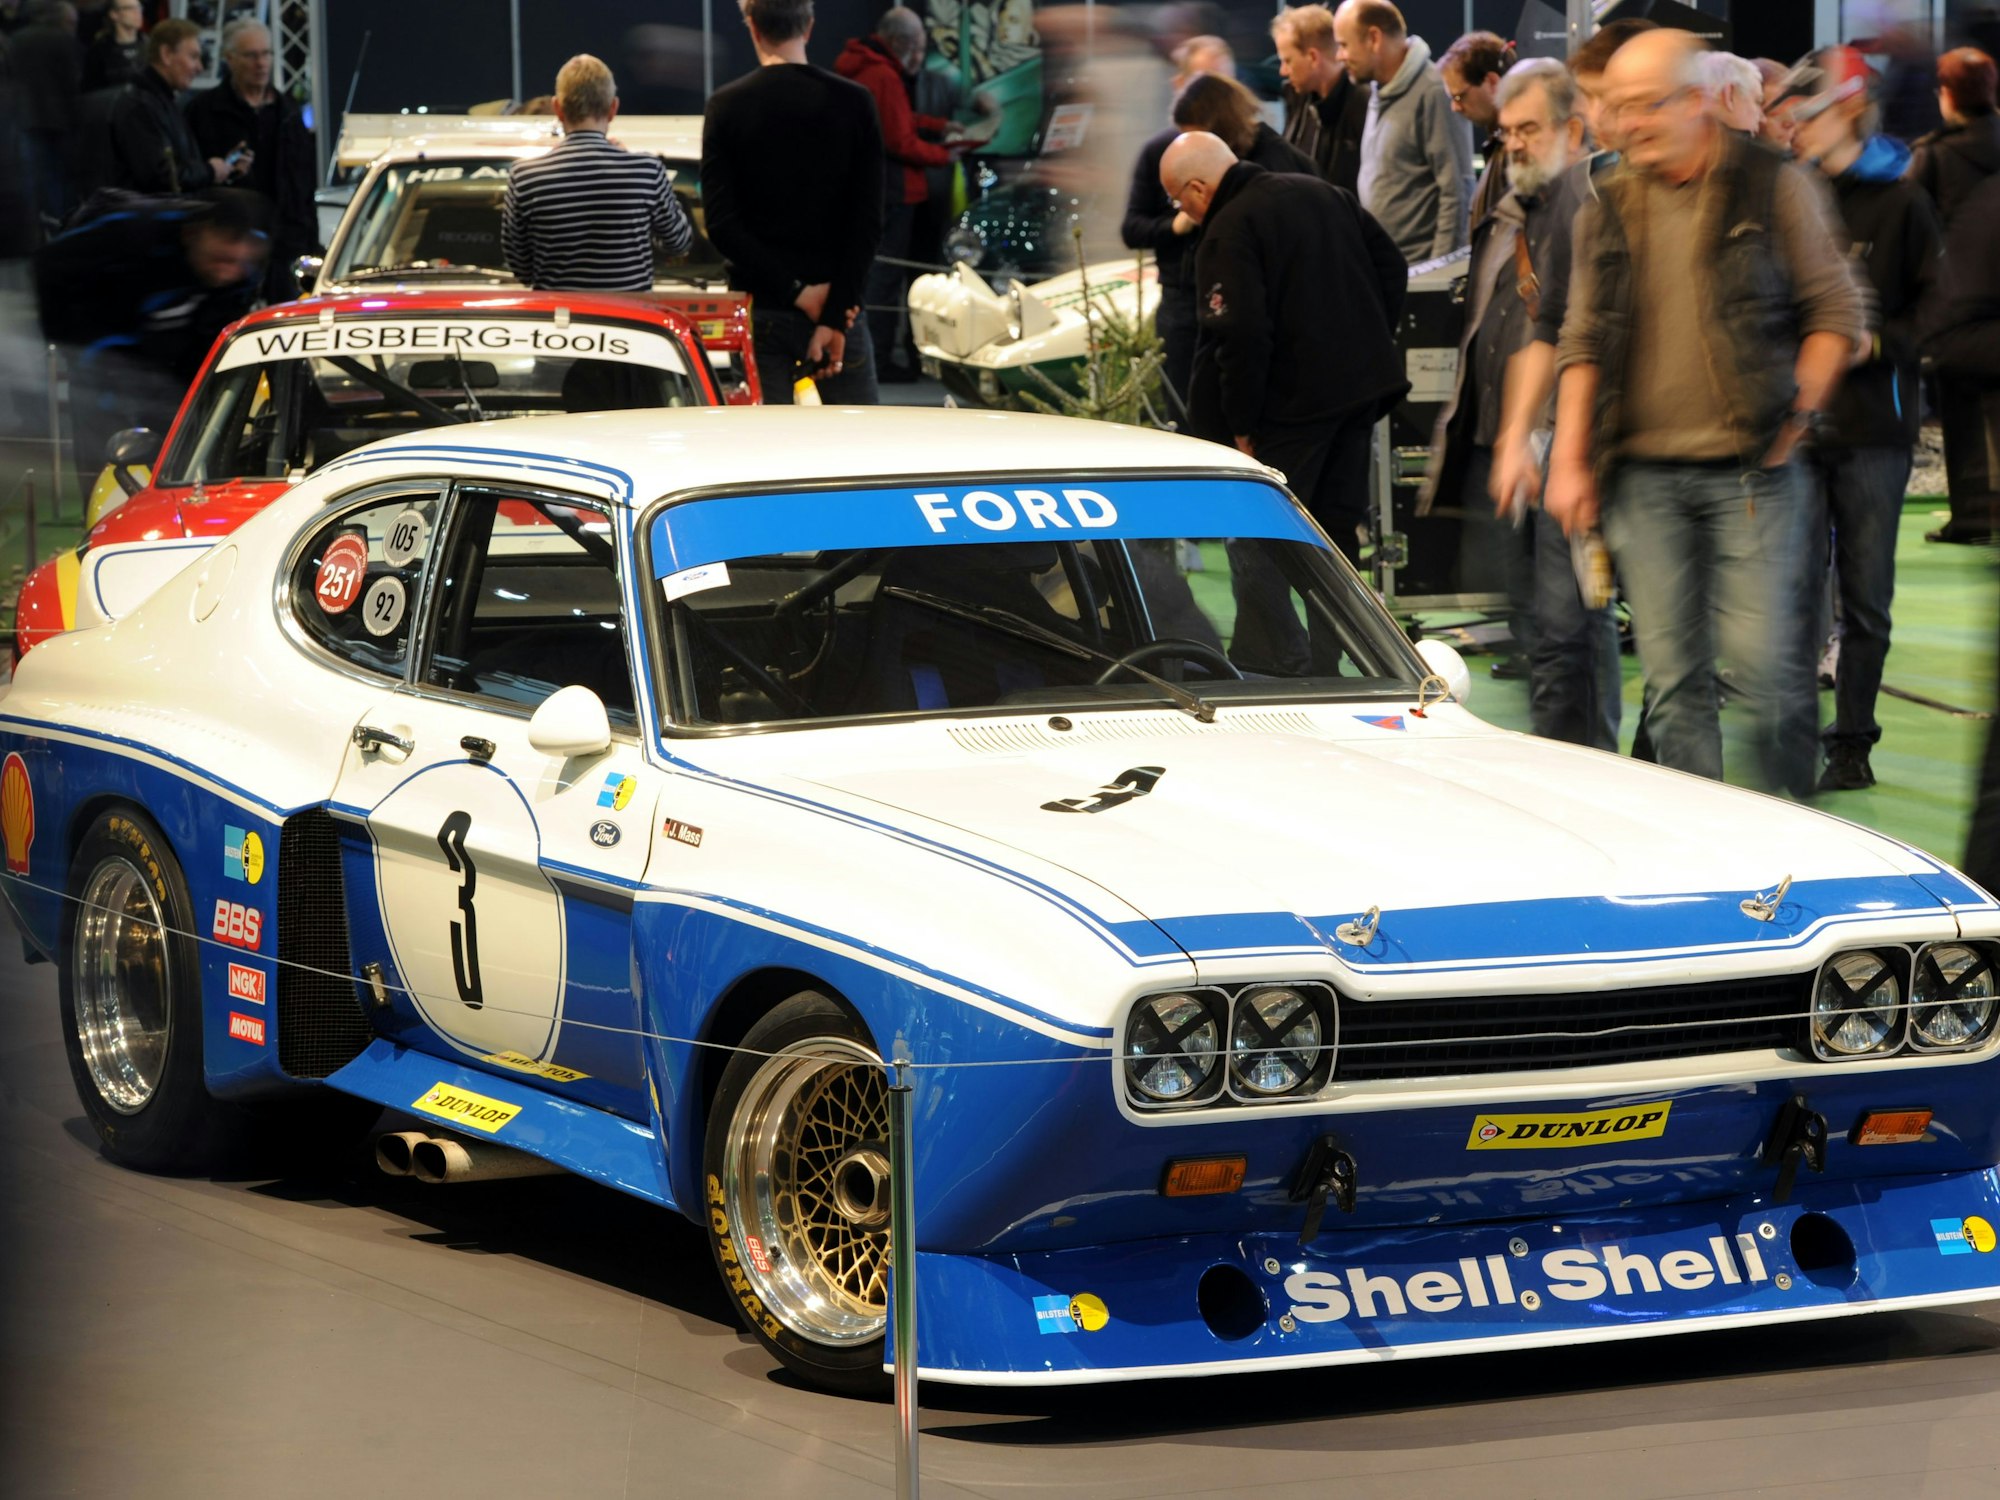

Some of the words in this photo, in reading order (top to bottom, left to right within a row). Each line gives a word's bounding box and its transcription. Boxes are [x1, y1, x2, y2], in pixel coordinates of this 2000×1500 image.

[405, 166, 463, 184] HB
[256, 325, 631, 356] WEISBERG-tools
[913, 489, 1119, 533] FORD
[389, 523, 419, 552] 105
[318, 563, 356, 601] 251
[374, 591, 395, 622] 92
[1039, 766, 1167, 814] 3
[593, 823, 616, 844] Ford
[669, 822, 677, 837] J.
[677, 824, 701, 845] Mass
[212, 899, 260, 944] BBS
[437, 811, 484, 1011] 3
[231, 968, 258, 998] NGK
[231, 1017, 263, 1042] MOTUL
[437, 1095, 511, 1124] DUNLOP
[1507, 1111, 1664, 1140] DUNLOP
[707, 1174, 784, 1339] DUNLOP
[748, 1237, 770, 1272] BBS
[1283, 1253, 1517, 1324] Shell
[1541, 1232, 1768, 1302] Shell
[1037, 1308, 1070, 1320] BILSTEIN
